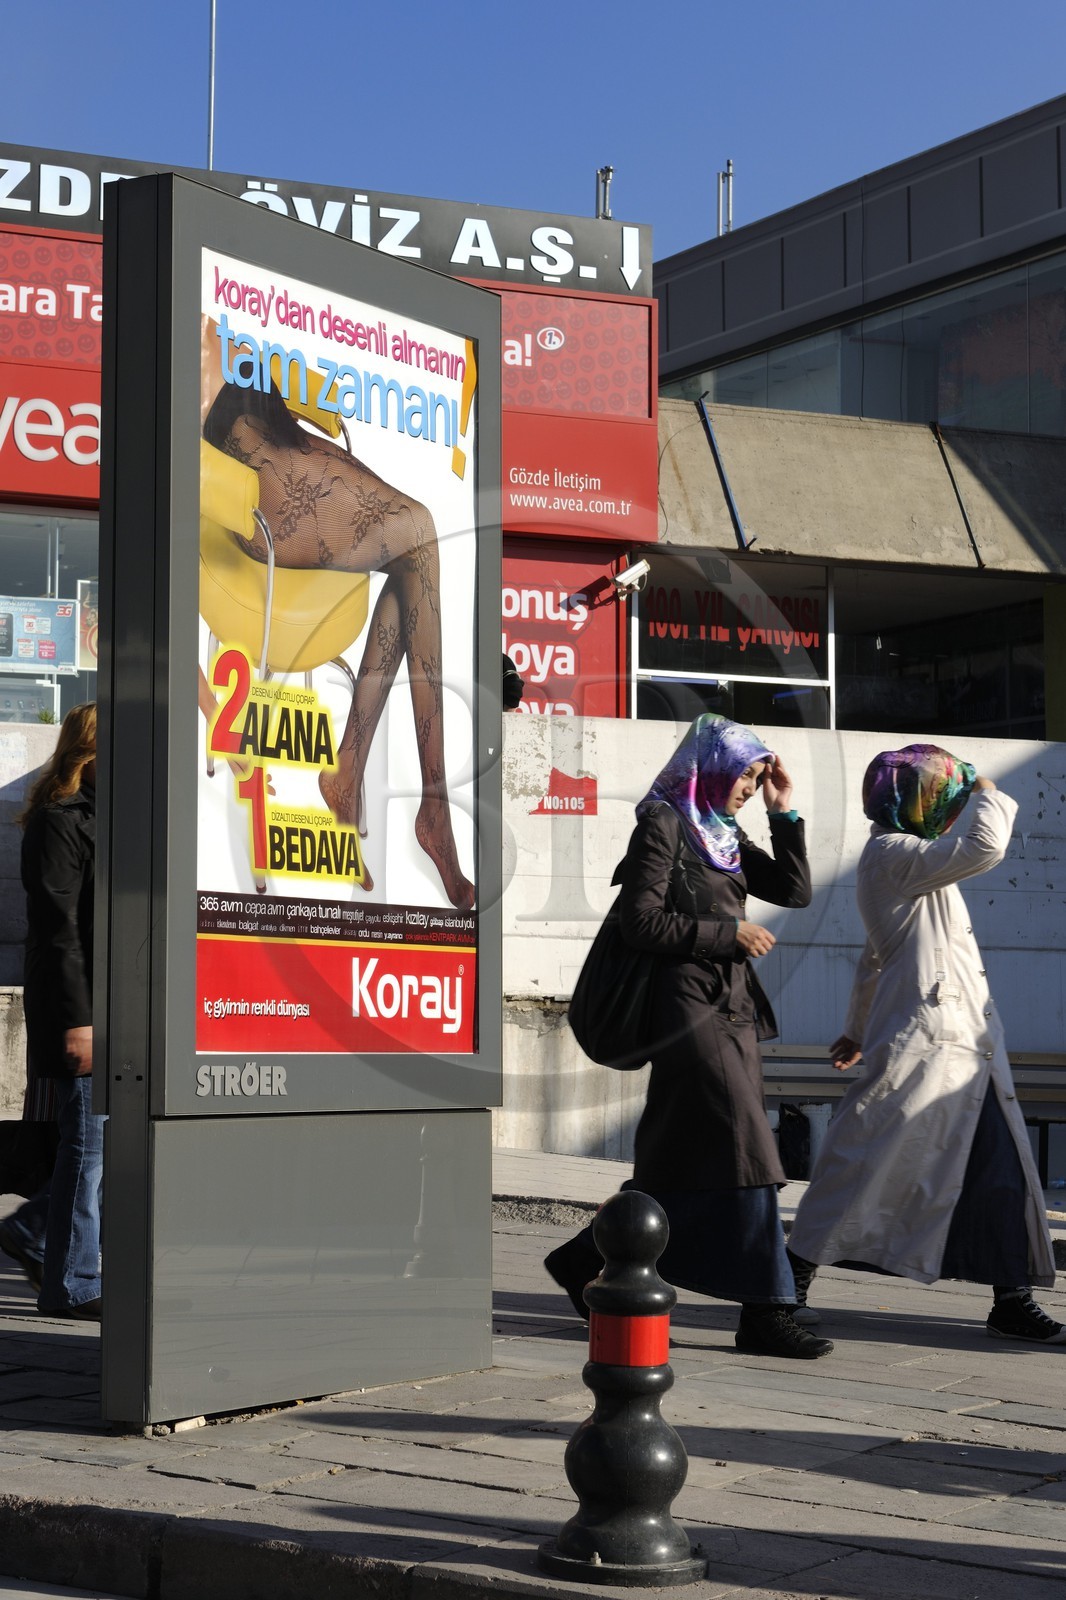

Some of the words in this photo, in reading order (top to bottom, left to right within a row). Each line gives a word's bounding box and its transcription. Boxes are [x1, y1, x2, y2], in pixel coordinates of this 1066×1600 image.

[450, 217, 597, 283] A.Ş.
[214, 266, 316, 334] koray'dan
[319, 304, 388, 358] desenli
[391, 330, 466, 383] almanın
[216, 313, 308, 406] tam
[509, 467, 550, 487] Gözde
[554, 468, 601, 492] İletişim
[509, 493, 632, 516] www.avea.com.tr
[211, 650, 250, 754] 2
[239, 702, 334, 765] ALANA
[239, 767, 267, 869] 1
[543, 796, 585, 810] NO:105
[269, 825, 360, 876] BEDAVA
[200, 896, 219, 911] 365
[220, 900, 243, 913] avm
[245, 901, 266, 917] cepa
[267, 902, 285, 916] avm
[287, 902, 317, 920] çankaya
[318, 904, 341, 919] tunalı
[405, 910, 429, 929] kızılay
[238, 919, 259, 933] balgat
[358, 928, 370, 938] ordu
[204, 998, 213, 1018] iç
[214, 998, 249, 1019] giyimin
[251, 999, 276, 1016] renkli
[277, 1000, 310, 1020] dünyası
[352, 956, 462, 1034] Koray
[196, 1062, 288, 1097] STRÖER
